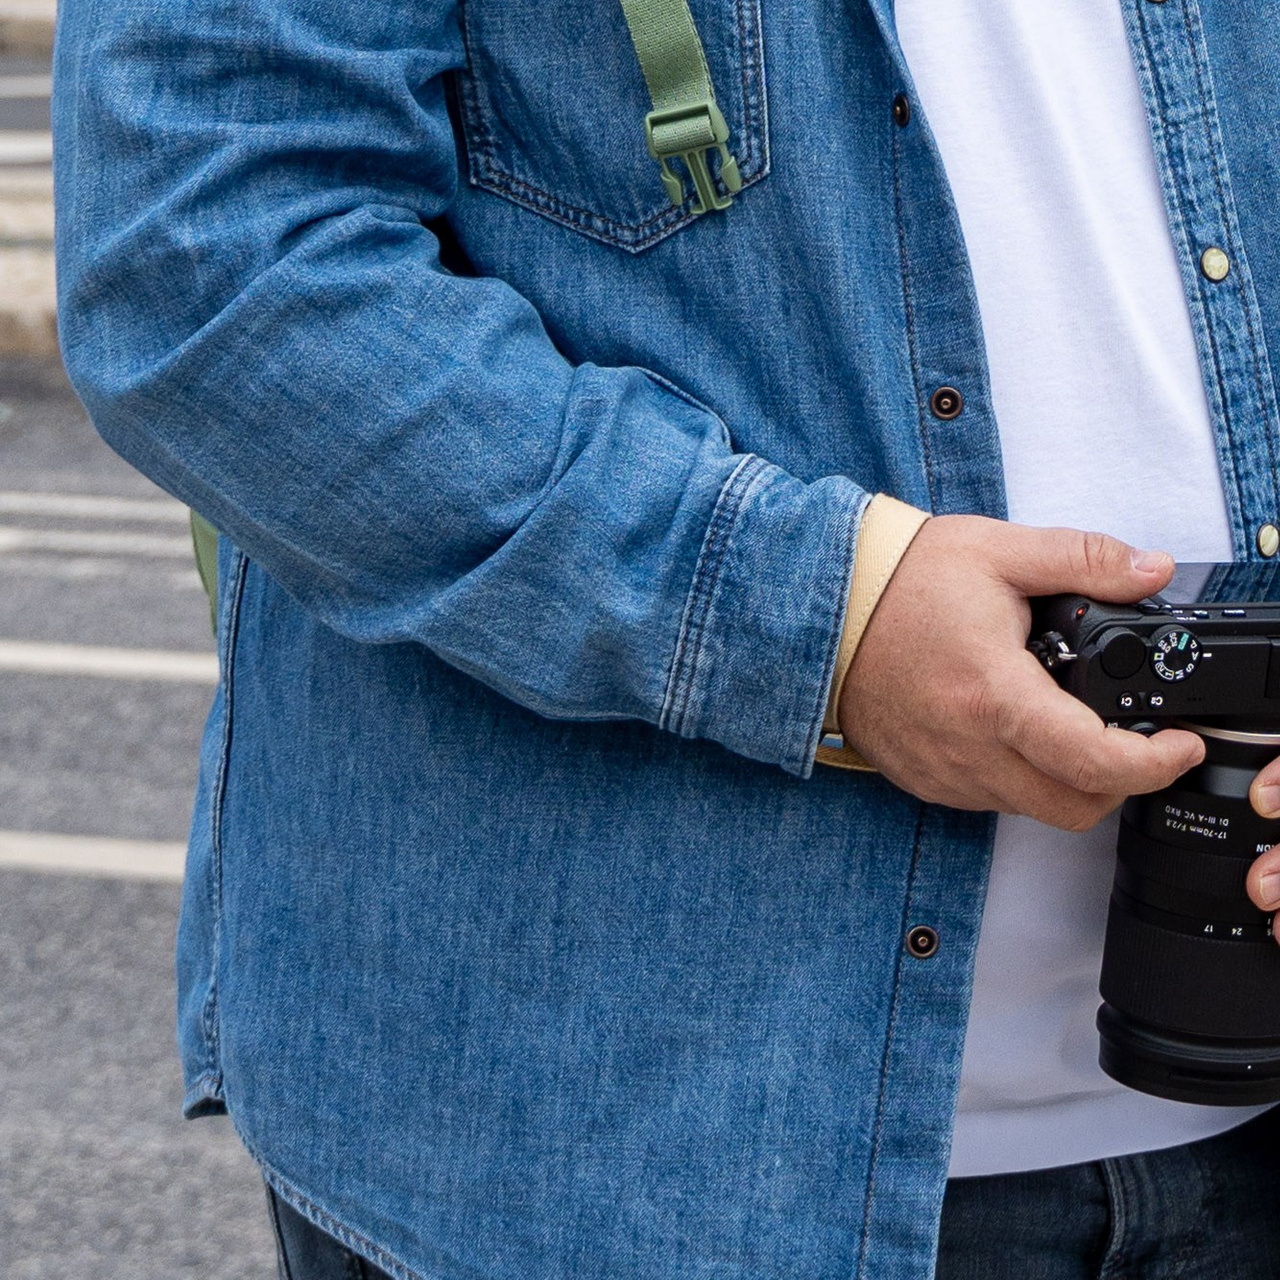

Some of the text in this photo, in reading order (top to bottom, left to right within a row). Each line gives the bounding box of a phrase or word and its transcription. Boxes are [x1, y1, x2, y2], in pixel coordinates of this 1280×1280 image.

[1121, 697, 1132, 707] C1
[1184, 810, 1195, 821] VC
[1166, 819, 1227, 840] 17-70mm F/2.8
[1204, 924, 1213, 933] 17
[1231, 927, 1243, 936] 24
